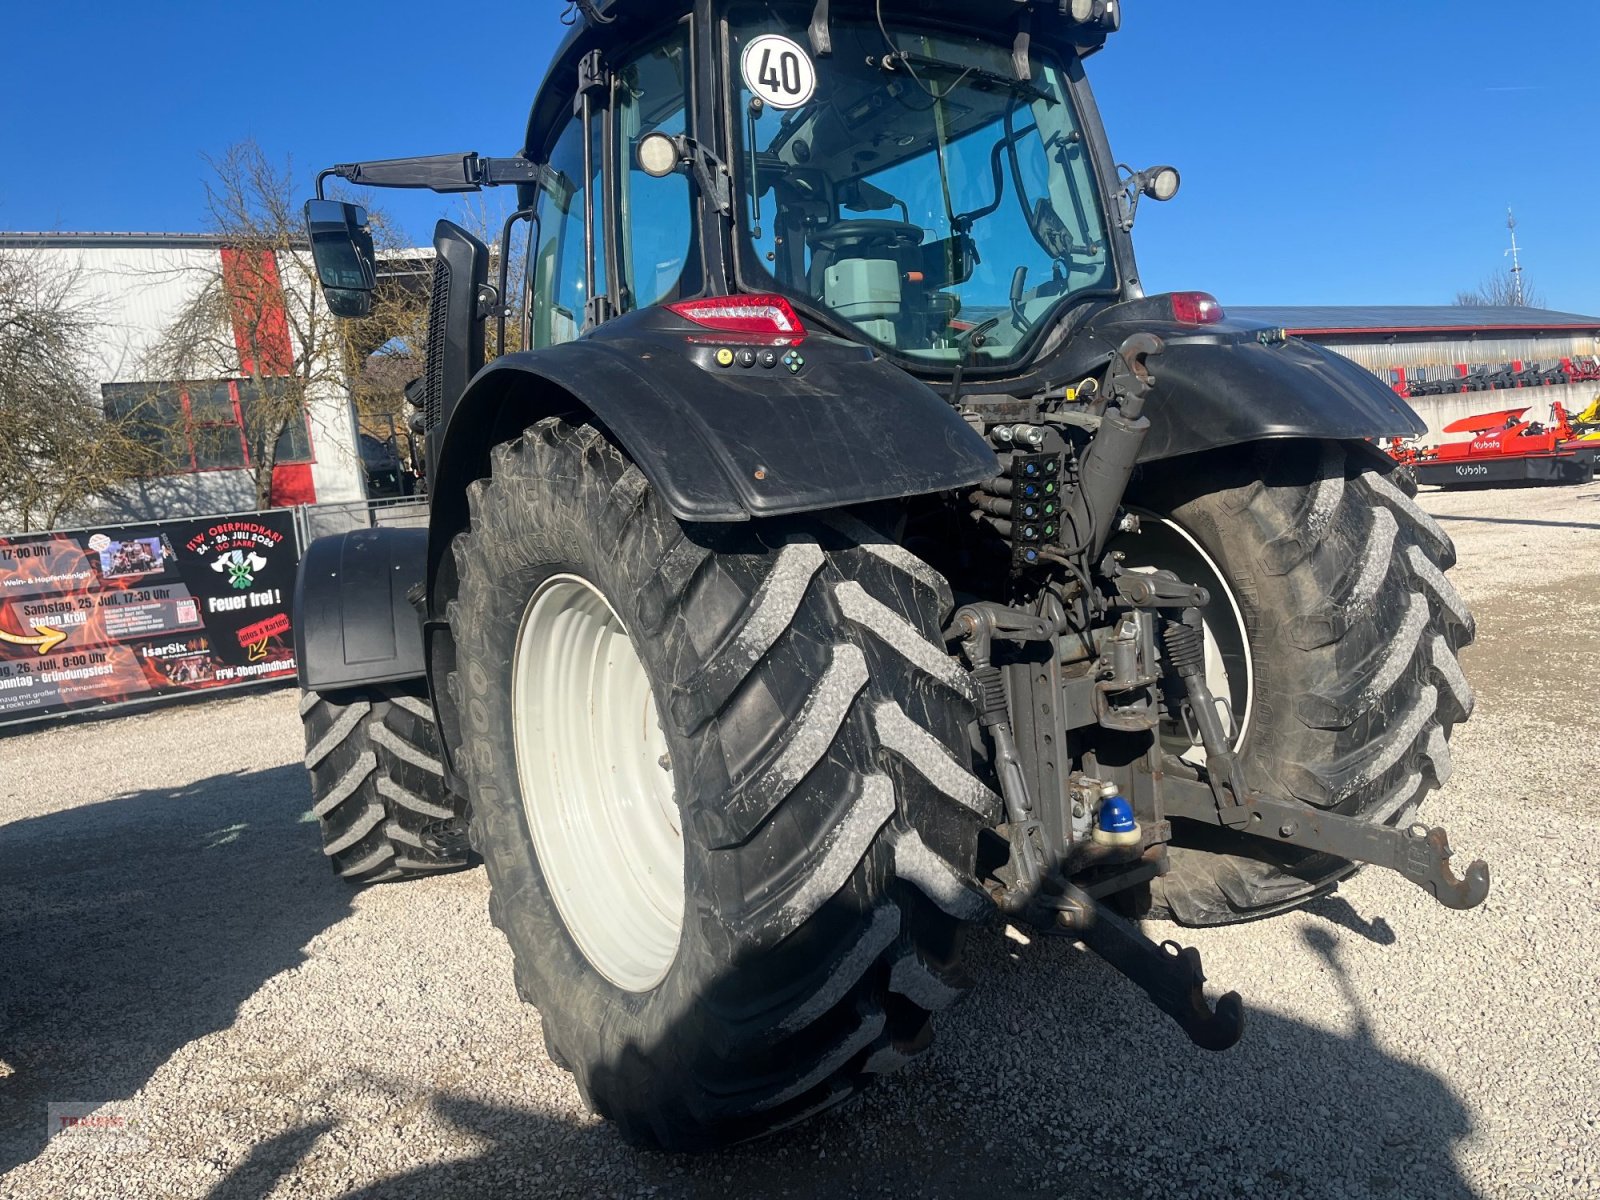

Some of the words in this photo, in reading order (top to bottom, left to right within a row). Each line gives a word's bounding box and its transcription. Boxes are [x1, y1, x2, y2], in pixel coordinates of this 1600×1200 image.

[759, 48, 801, 95] 40
[1473, 440, 1500, 449] Kubota
[1455, 464, 1488, 475] Kubota
[216, 533, 230, 543] 26.
[232, 531, 250, 540] JULI
[251, 533, 275, 548] 2026
[2, 547, 31, 561] 17:00
[33, 545, 52, 557] Uhr
[24, 601, 76, 616] Samstag,
[78, 598, 95, 609] 25.
[98, 594, 121, 607] Juli,
[123, 591, 151, 604] 17:30
[153, 588, 170, 600] Uhr
[208, 594, 248, 613] Feuer
[250, 589, 273, 608] frei
[275, 588, 281, 604] !
[29, 615, 62, 629] Stefan
[63, 611, 87, 624] Kröll
[142, 642, 187, 657] IsarSix
[16, 662, 34, 674] 26.
[37, 659, 60, 671] Juli,
[62, 655, 87, 668] 8:00
[89, 653, 107, 664] Uhr
[41, 664, 113, 683] Gründungsfest
